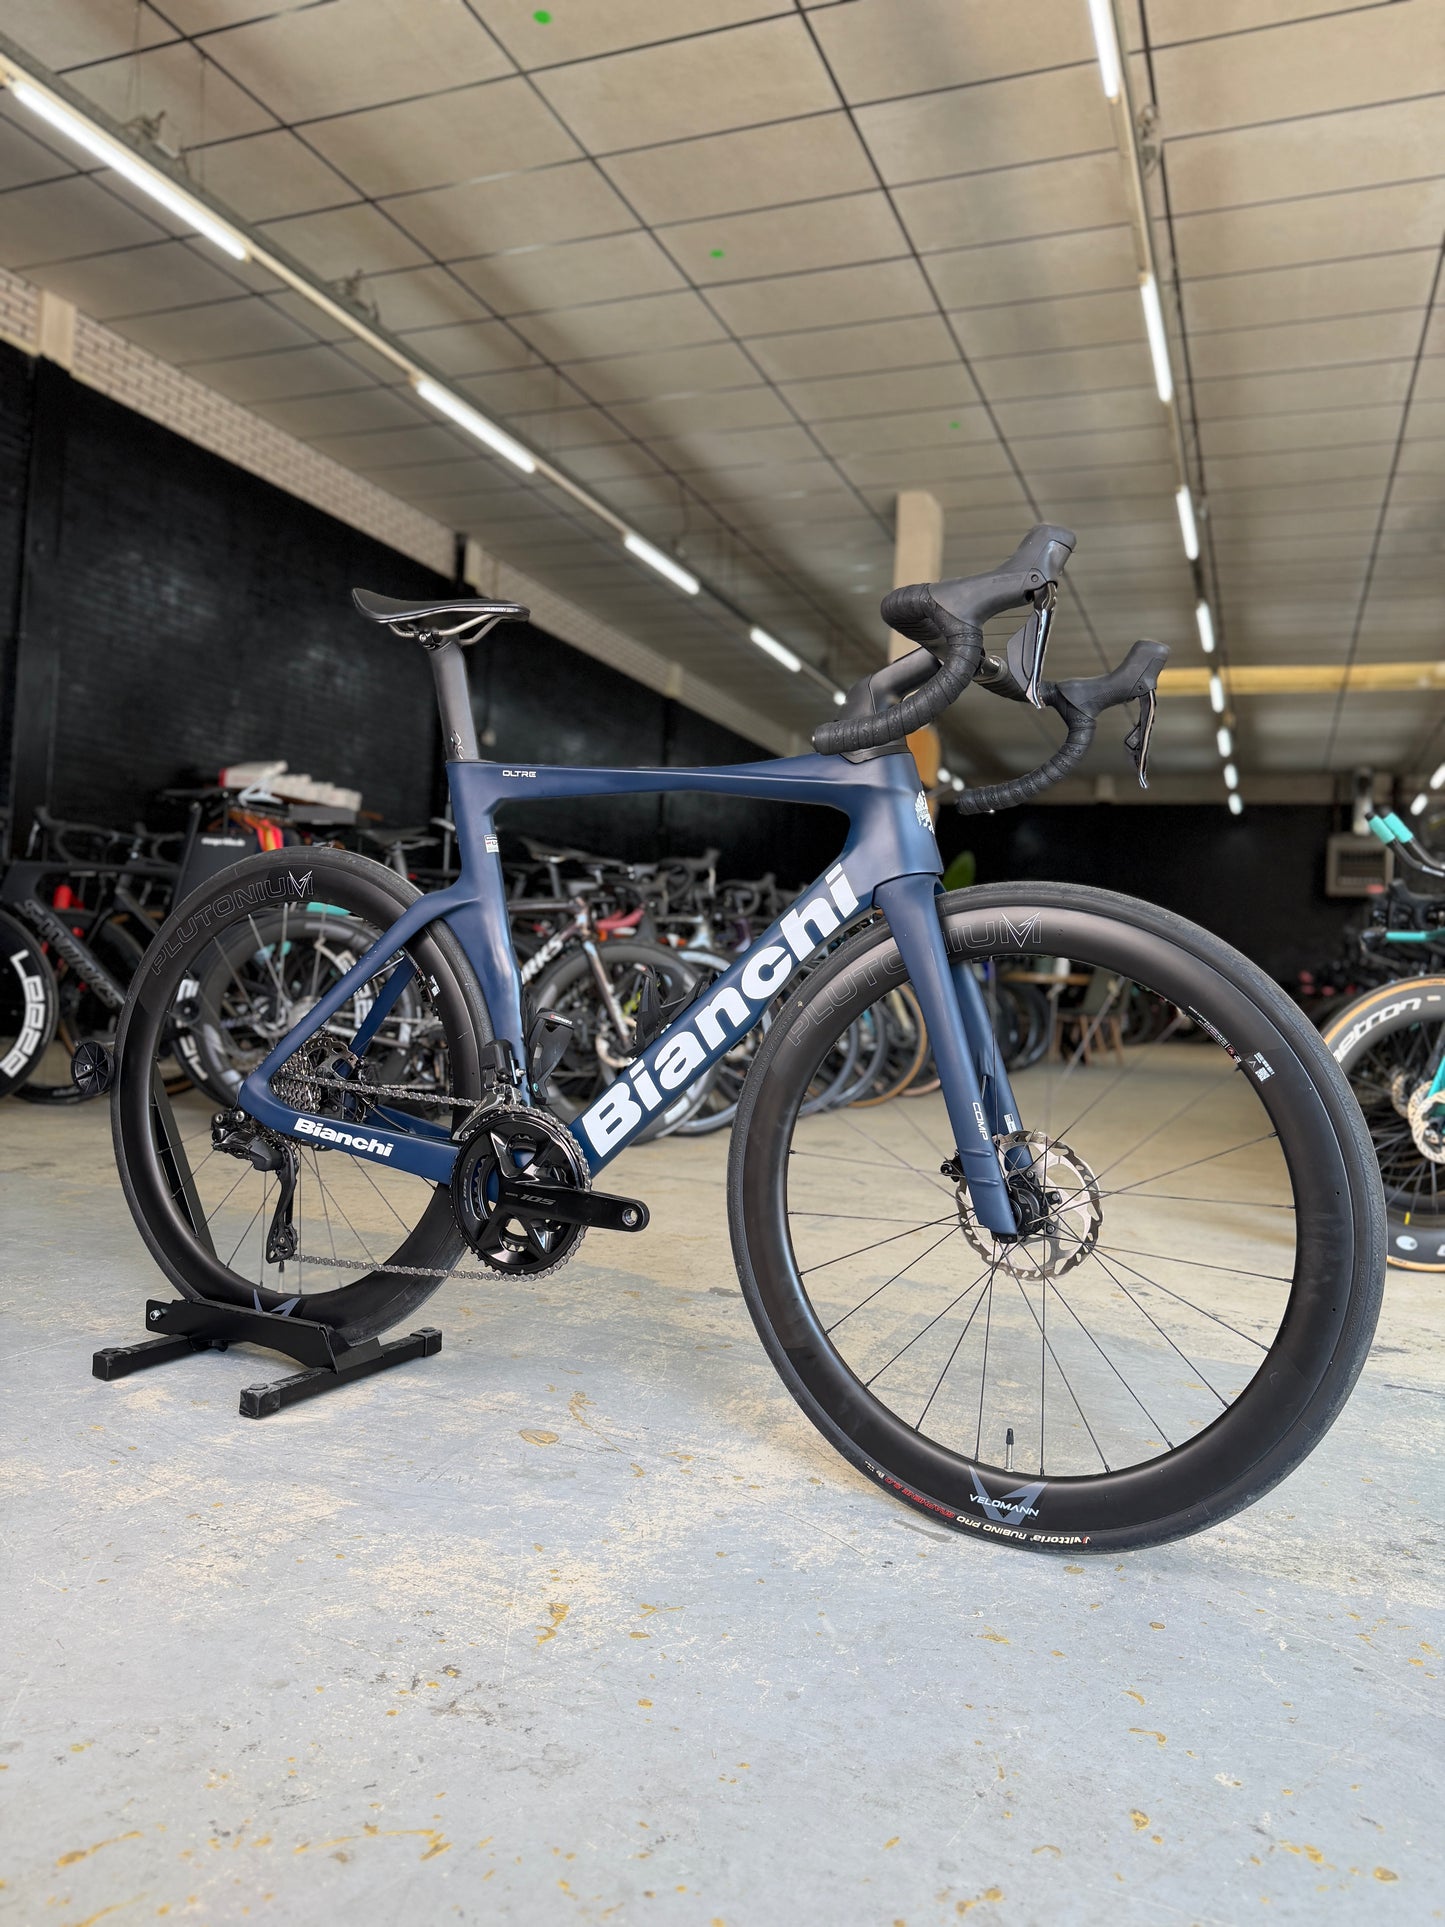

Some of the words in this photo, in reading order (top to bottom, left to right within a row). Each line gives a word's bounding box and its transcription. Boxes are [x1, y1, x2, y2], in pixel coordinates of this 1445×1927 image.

[502, 769, 537, 778] OLTRE
[150, 871, 314, 975] PLUTONIUM
[787, 912, 1042, 1046] PLUTOIUM
[582, 862, 860, 1157] Bianchi
[972, 1102, 989, 1141] COMP
[294, 1118, 393, 1157] Bianchi
[520, 1193, 557, 1206] 105
[969, 1494, 1040, 1517] VELOMANN
[956, 1515, 981, 1528] PRO
[982, 1524, 1028, 1541] RUBINO
